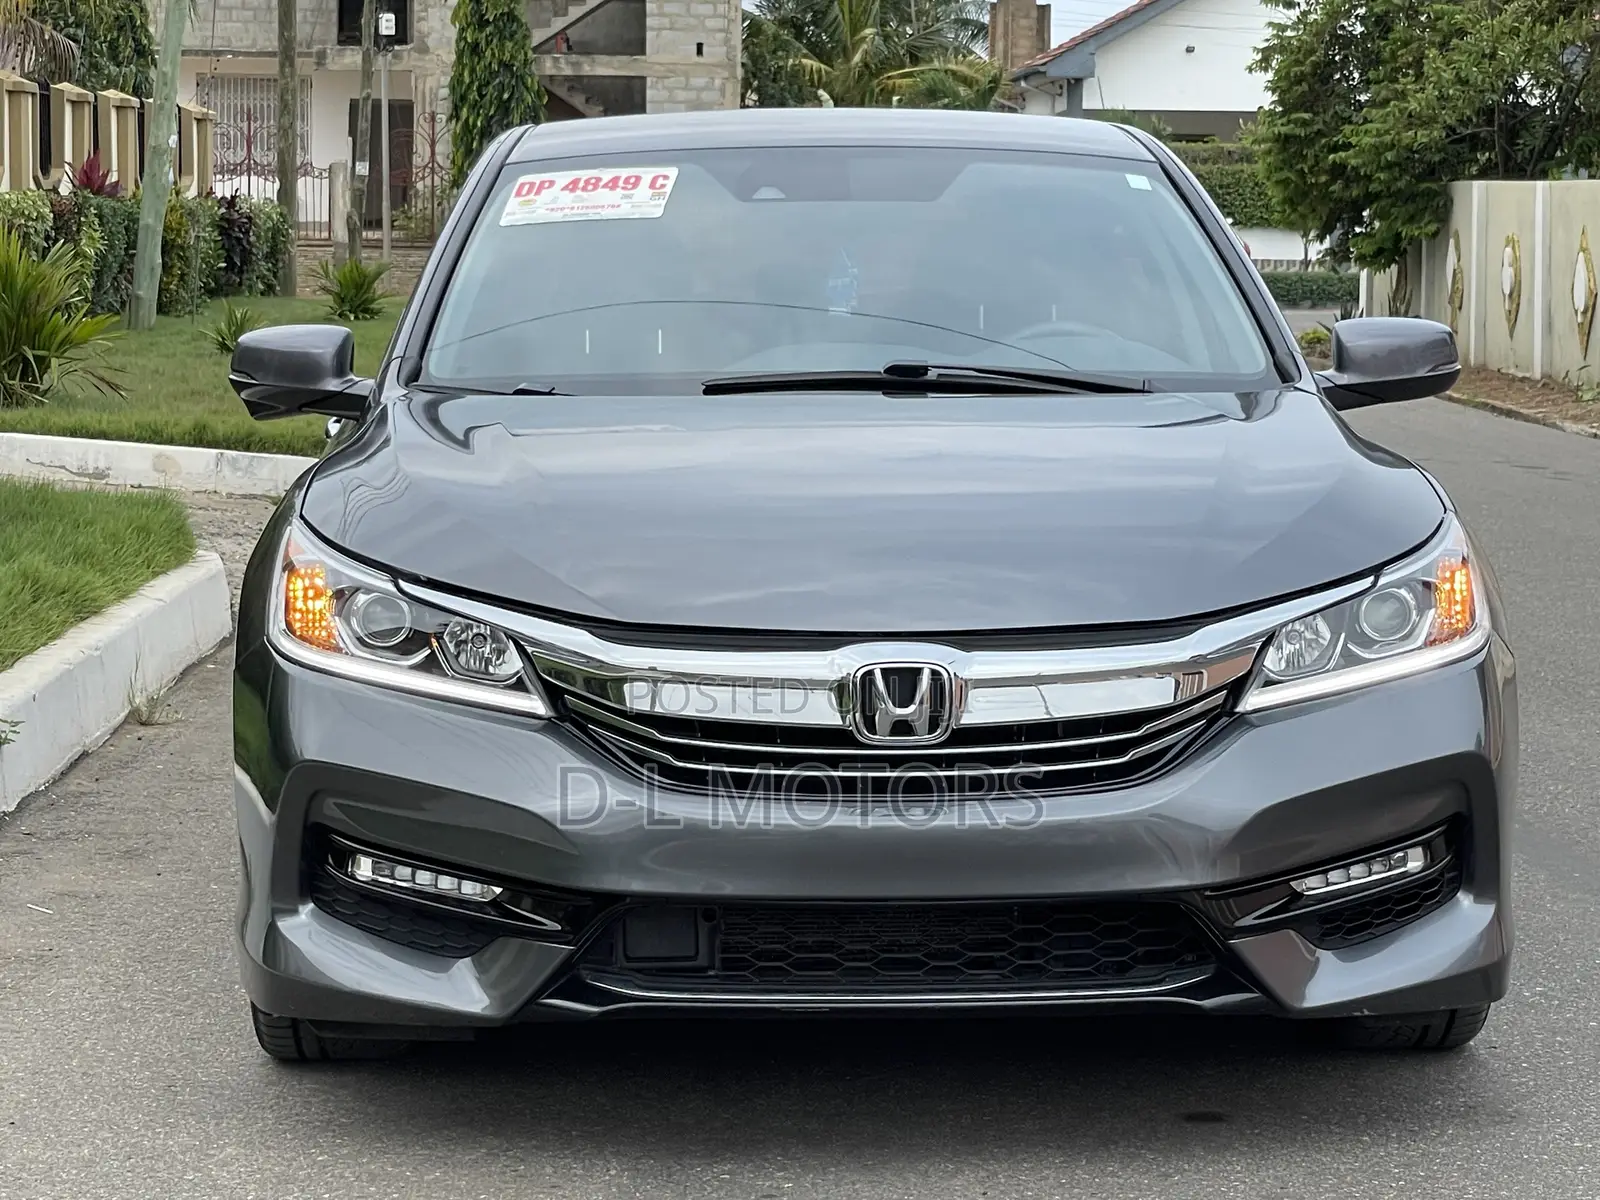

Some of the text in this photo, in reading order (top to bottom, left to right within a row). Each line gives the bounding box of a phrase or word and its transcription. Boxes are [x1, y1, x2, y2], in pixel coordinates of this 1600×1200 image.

[515, 175, 670, 198] DP 4849 C
